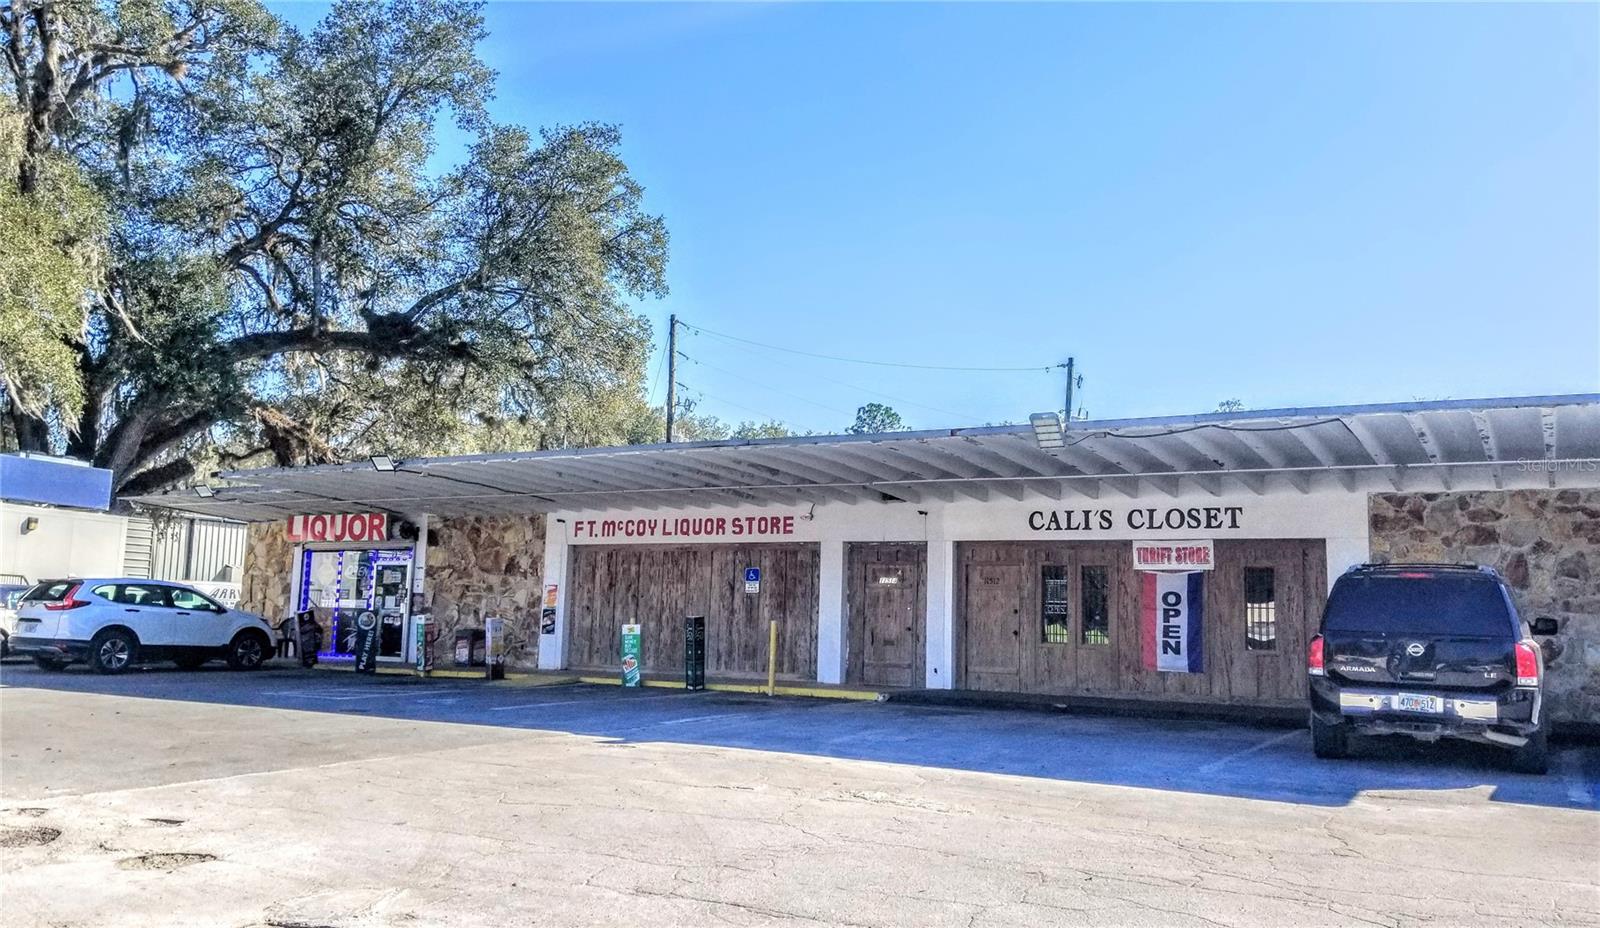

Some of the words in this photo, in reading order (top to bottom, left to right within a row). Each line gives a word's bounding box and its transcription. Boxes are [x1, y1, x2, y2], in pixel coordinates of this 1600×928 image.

[287, 513, 385, 542] LIQUOR
[574, 520, 598, 538] FT.
[662, 518, 726, 537] LIQUOR
[732, 516, 794, 535] STORE
[1028, 509, 1113, 531] CALI'S
[1127, 507, 1243, 530] CLOSET
[1136, 546, 1172, 564] THRIFT
[1175, 546, 1211, 565] STORE
[1162, 591, 1182, 656] OPEN
[359, 652, 368, 670] PLAY
[1340, 665, 1376, 673] ARMADA
